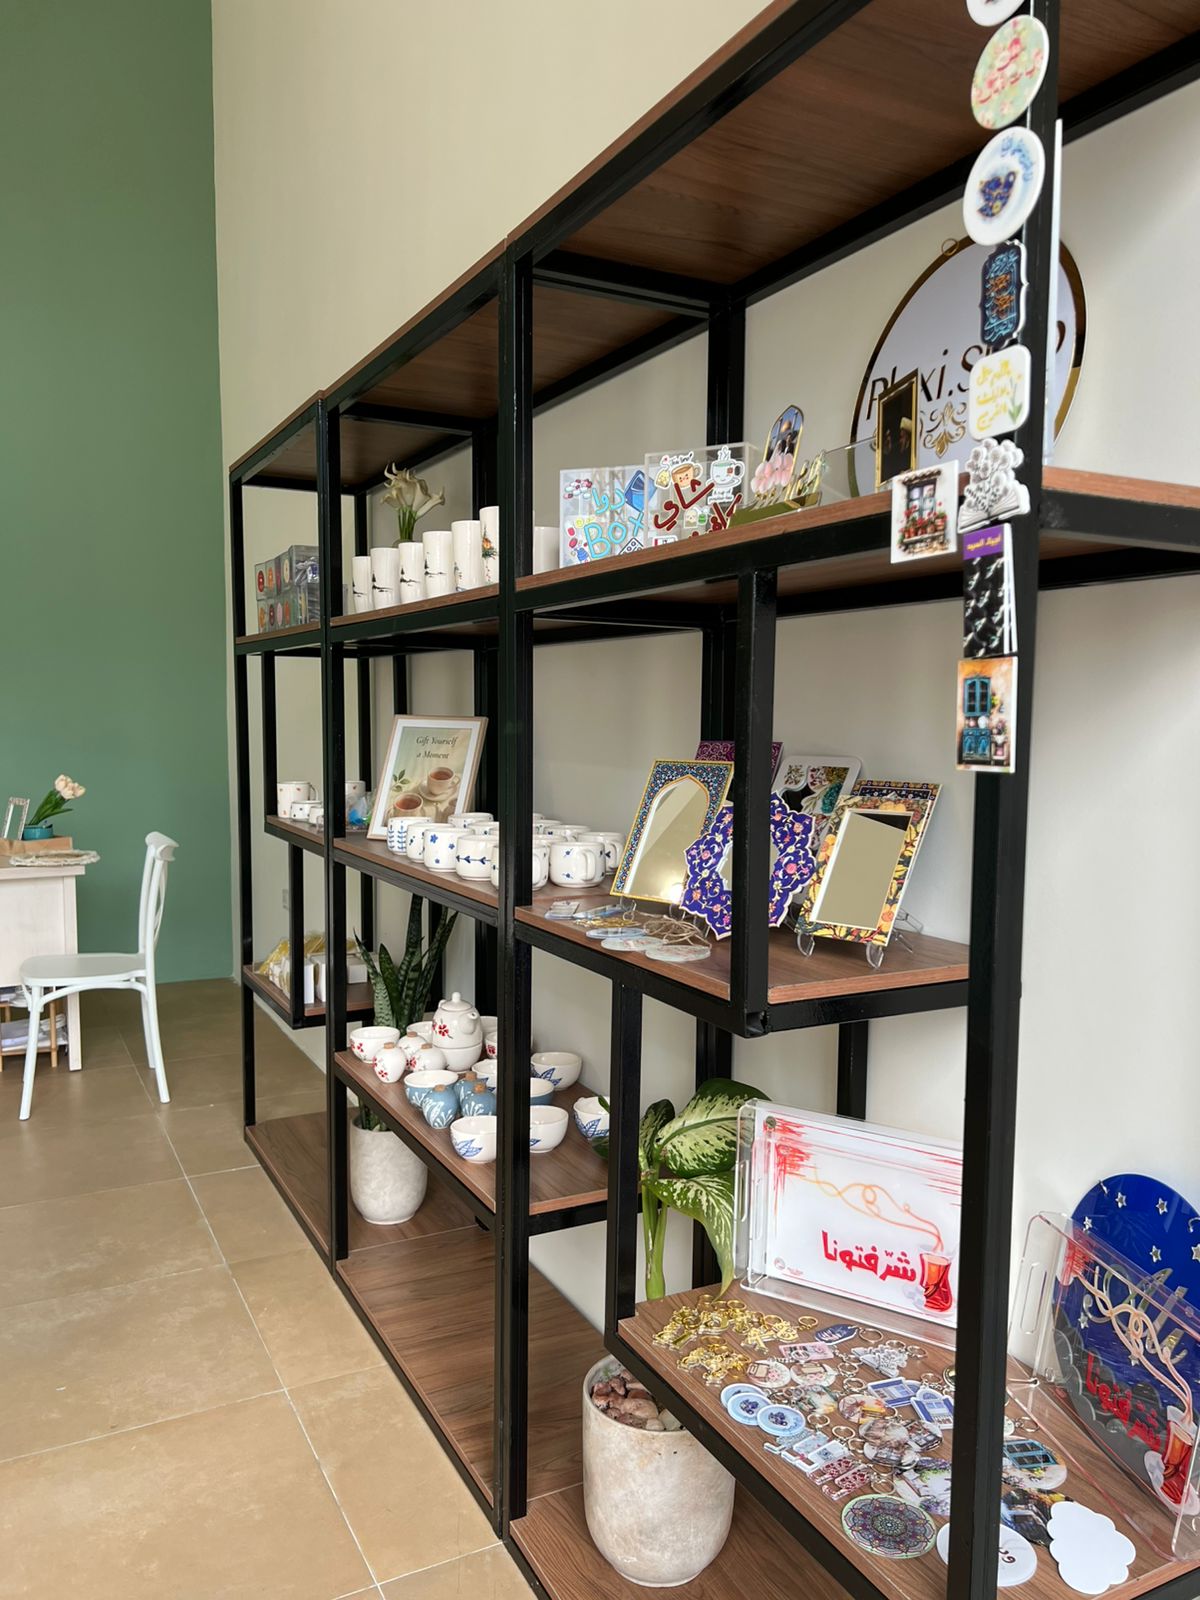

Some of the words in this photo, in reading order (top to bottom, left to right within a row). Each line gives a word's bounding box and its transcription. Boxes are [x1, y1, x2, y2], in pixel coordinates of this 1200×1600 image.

[416, 736, 429, 746] Gift
[431, 736, 459, 747] Yourself
[424, 750, 449, 759] Moment
